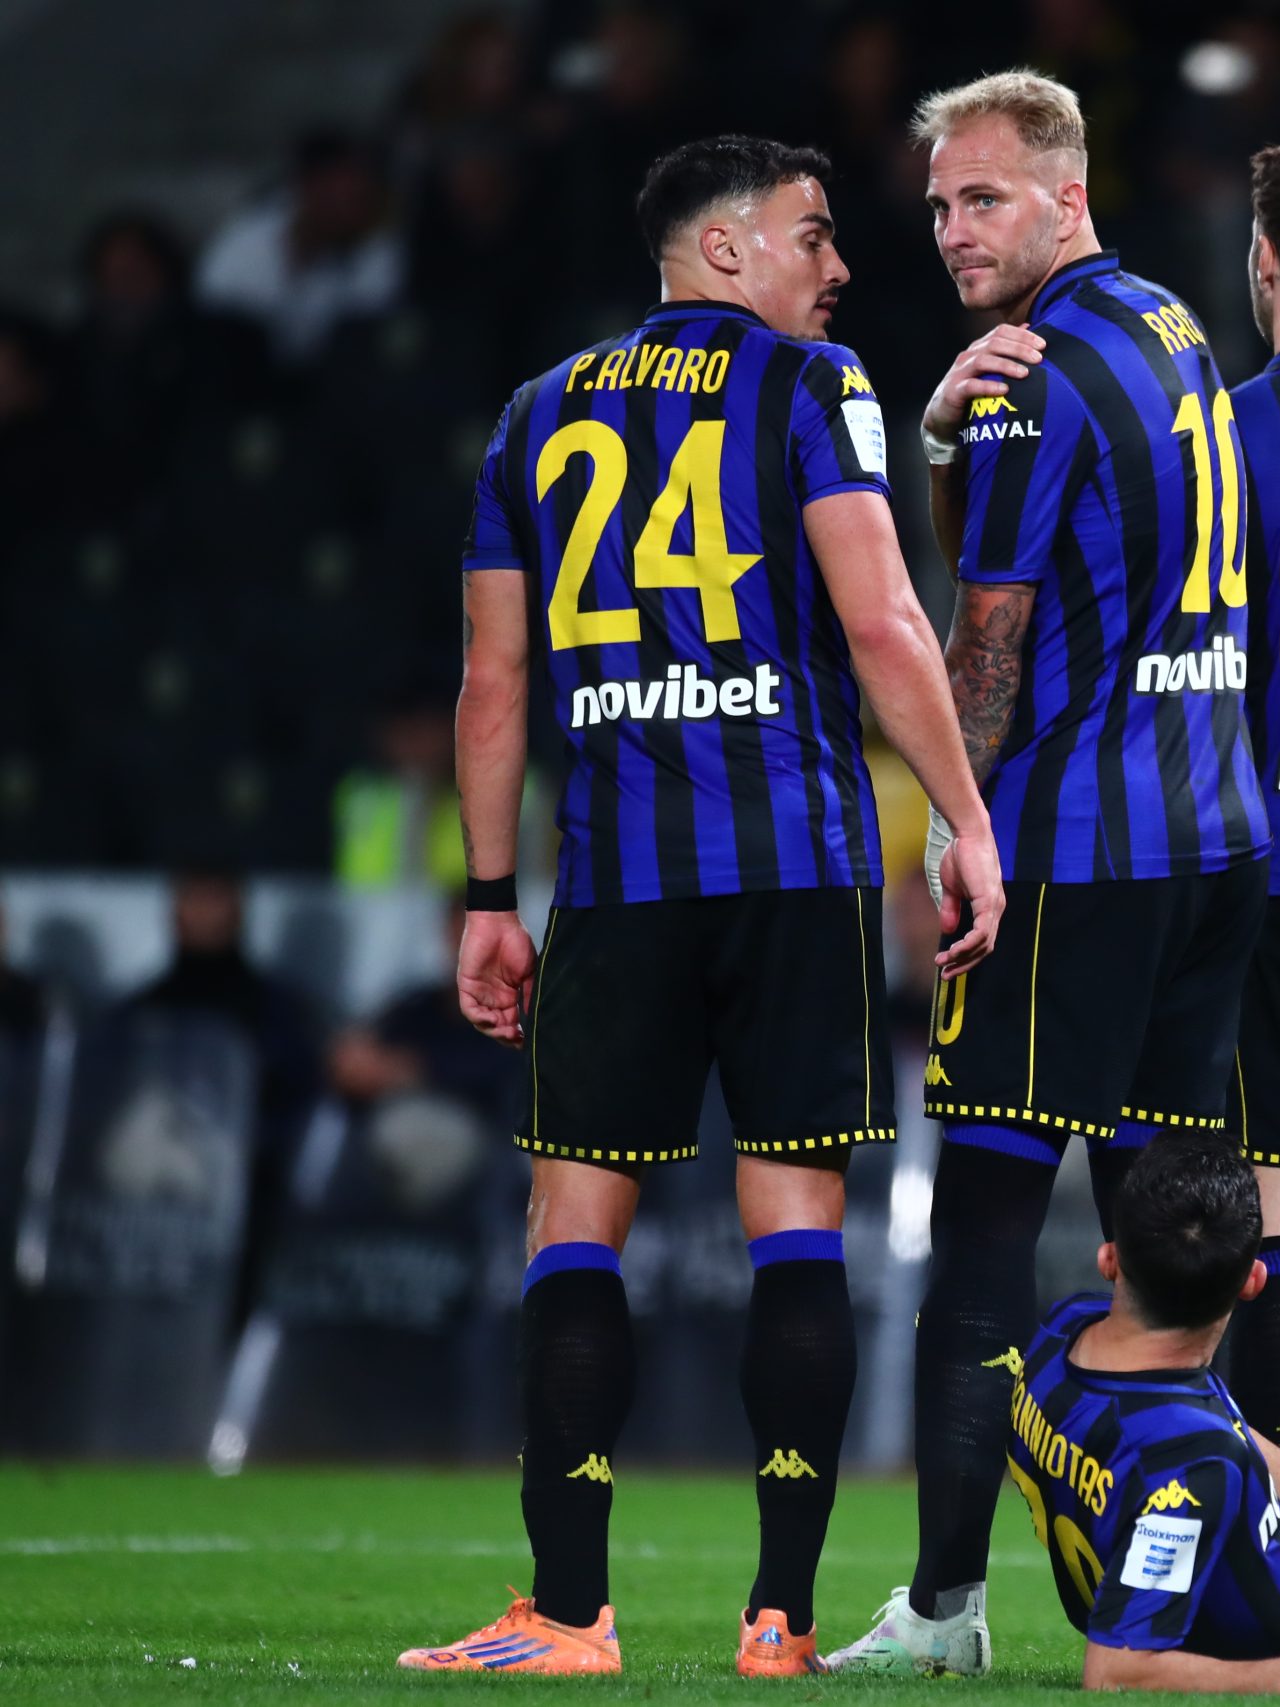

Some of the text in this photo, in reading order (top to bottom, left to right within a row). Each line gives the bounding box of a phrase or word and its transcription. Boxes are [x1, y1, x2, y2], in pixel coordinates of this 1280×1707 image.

[565, 343, 730, 394] P.ALVARO
[536, 420, 764, 651] 24
[1171, 388, 1247, 613] 10
[571, 664, 780, 728] novibet
